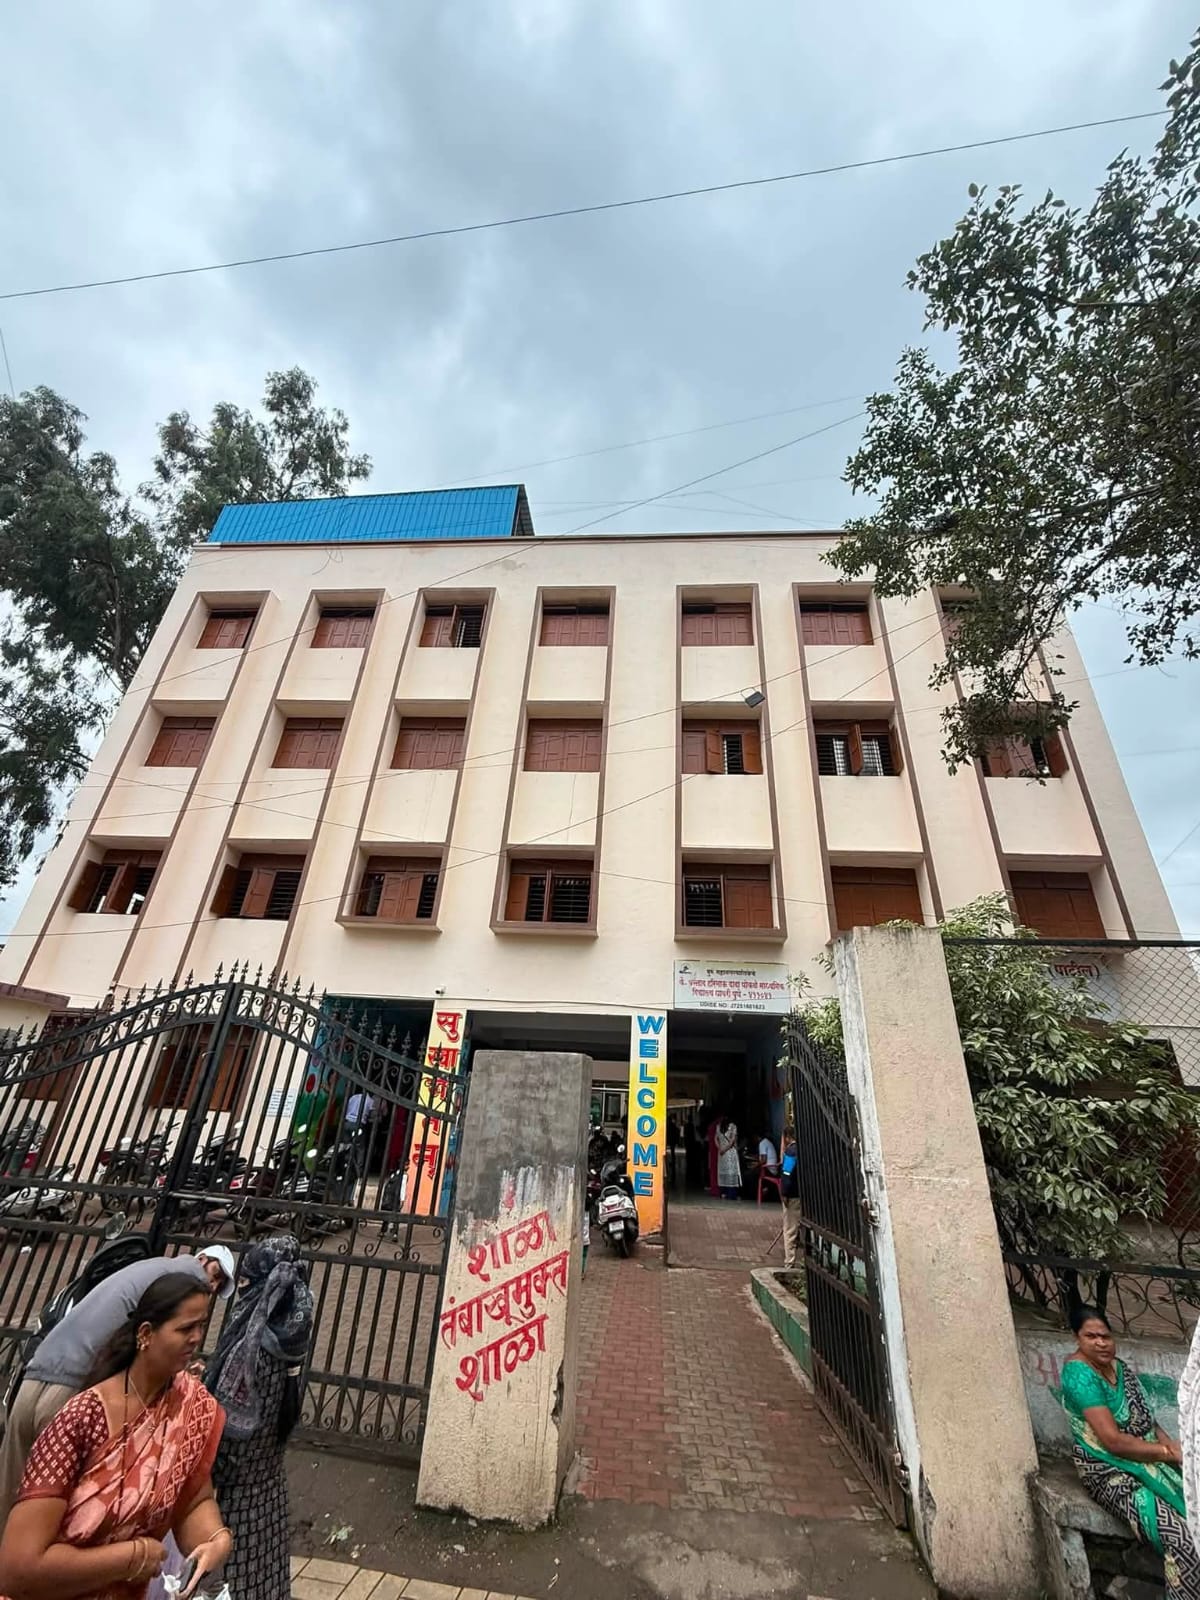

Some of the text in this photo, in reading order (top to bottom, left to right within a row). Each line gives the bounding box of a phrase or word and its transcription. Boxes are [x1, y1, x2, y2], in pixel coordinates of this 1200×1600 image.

[633, 1015, 666, 1196] WELCOME
[467, 1210, 557, 1283] शाळा
[439, 1250, 570, 1349] तंबाखूमुक्त
[456, 1313, 549, 1402] शाळा
